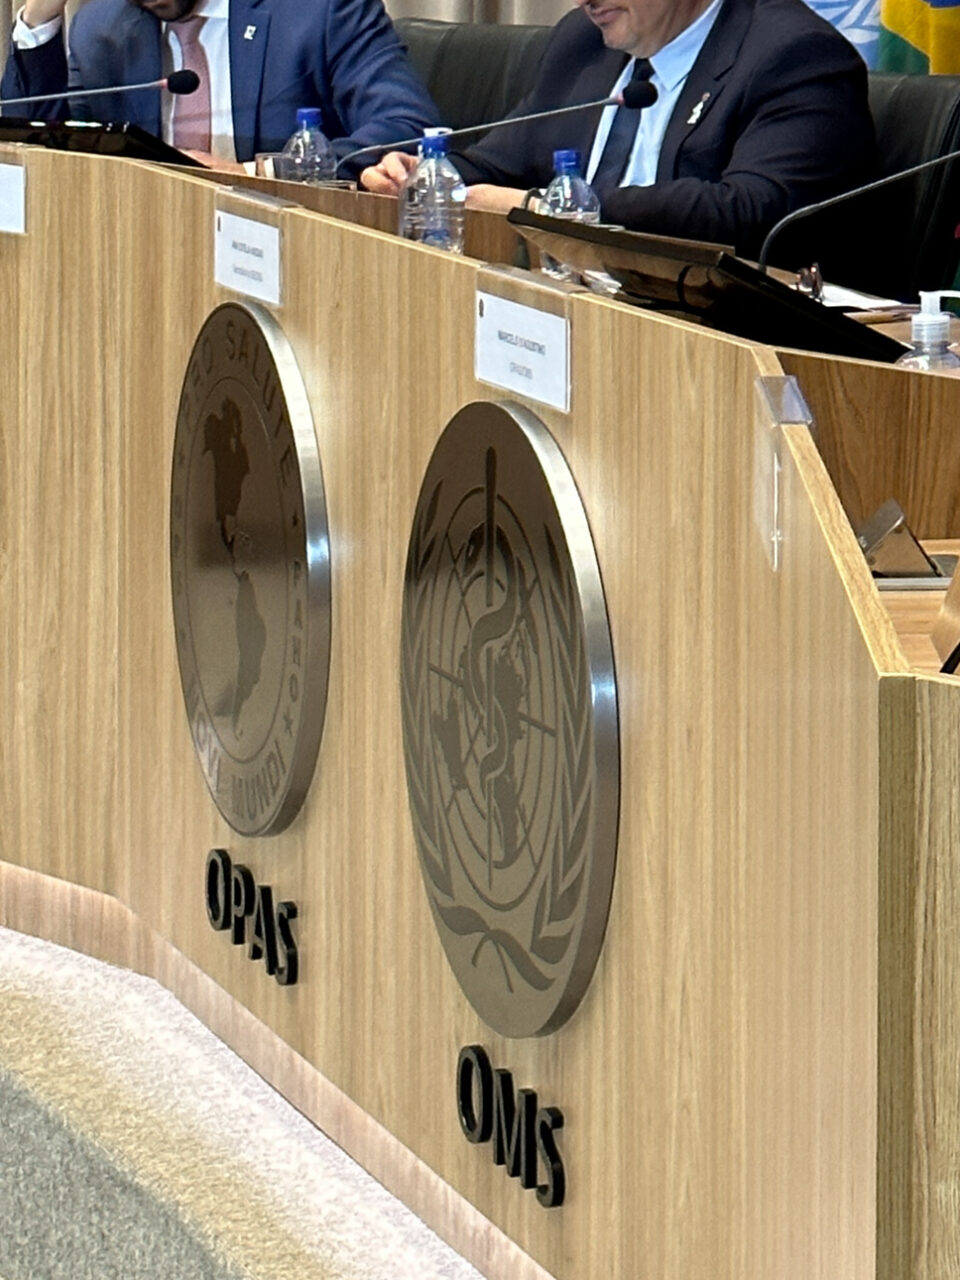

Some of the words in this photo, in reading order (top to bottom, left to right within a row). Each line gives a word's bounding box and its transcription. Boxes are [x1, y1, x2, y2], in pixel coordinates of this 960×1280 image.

[226, 320, 293, 488] SALUTE
[231, 739, 287, 821] MUNDI
[205, 848, 298, 986] OPAS
[456, 1045, 565, 1208] OMS
